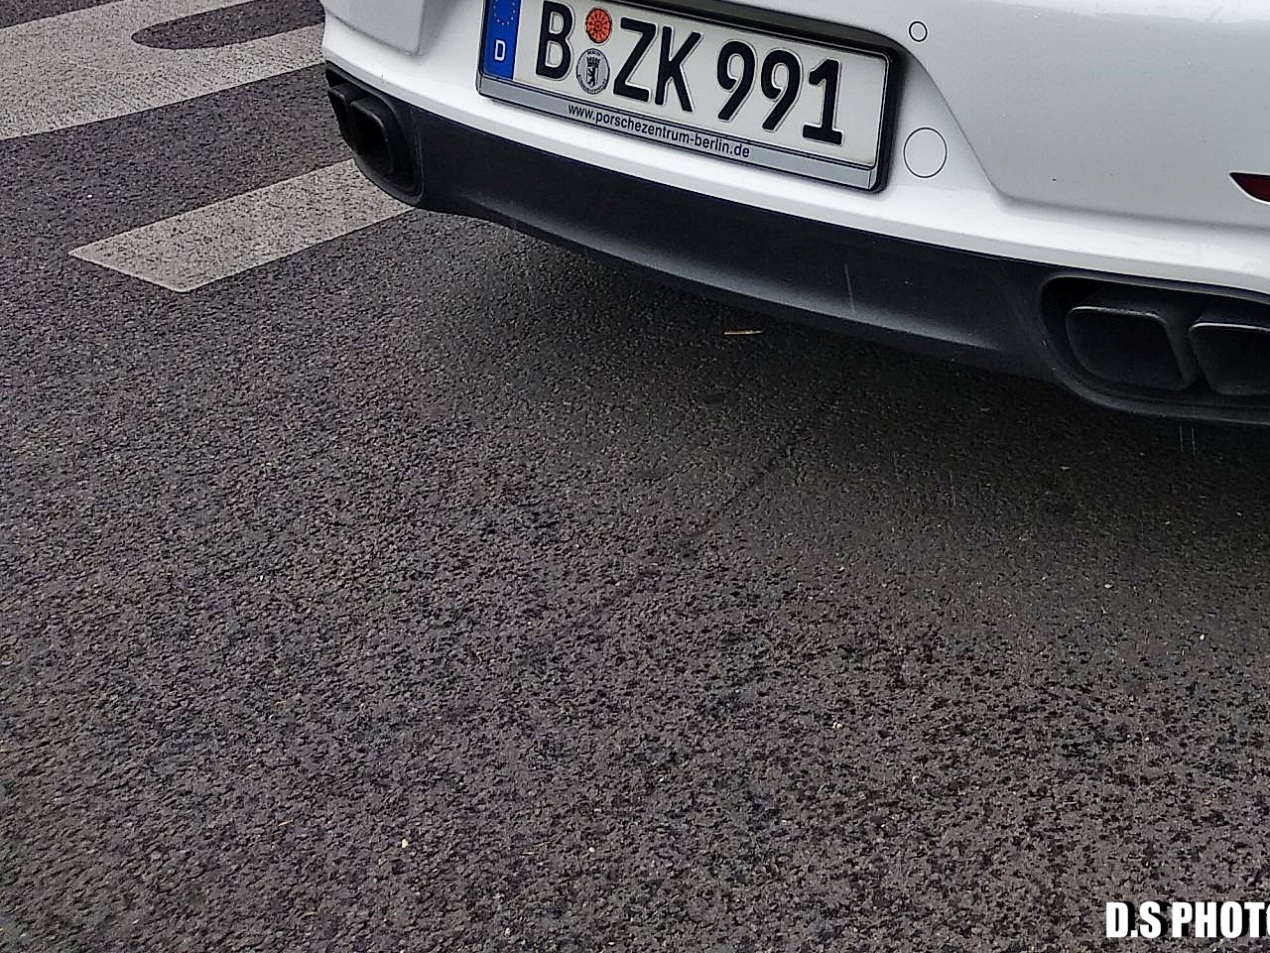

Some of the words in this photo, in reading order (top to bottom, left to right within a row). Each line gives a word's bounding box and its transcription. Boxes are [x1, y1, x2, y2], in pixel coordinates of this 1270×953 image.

[494, 39, 506, 61] D
[536, 0, 573, 79] B
[613, 17, 702, 113] ZK
[716, 40, 844, 147] 991
[568, 103, 751, 159] www.porschezentrum-berlin.de
